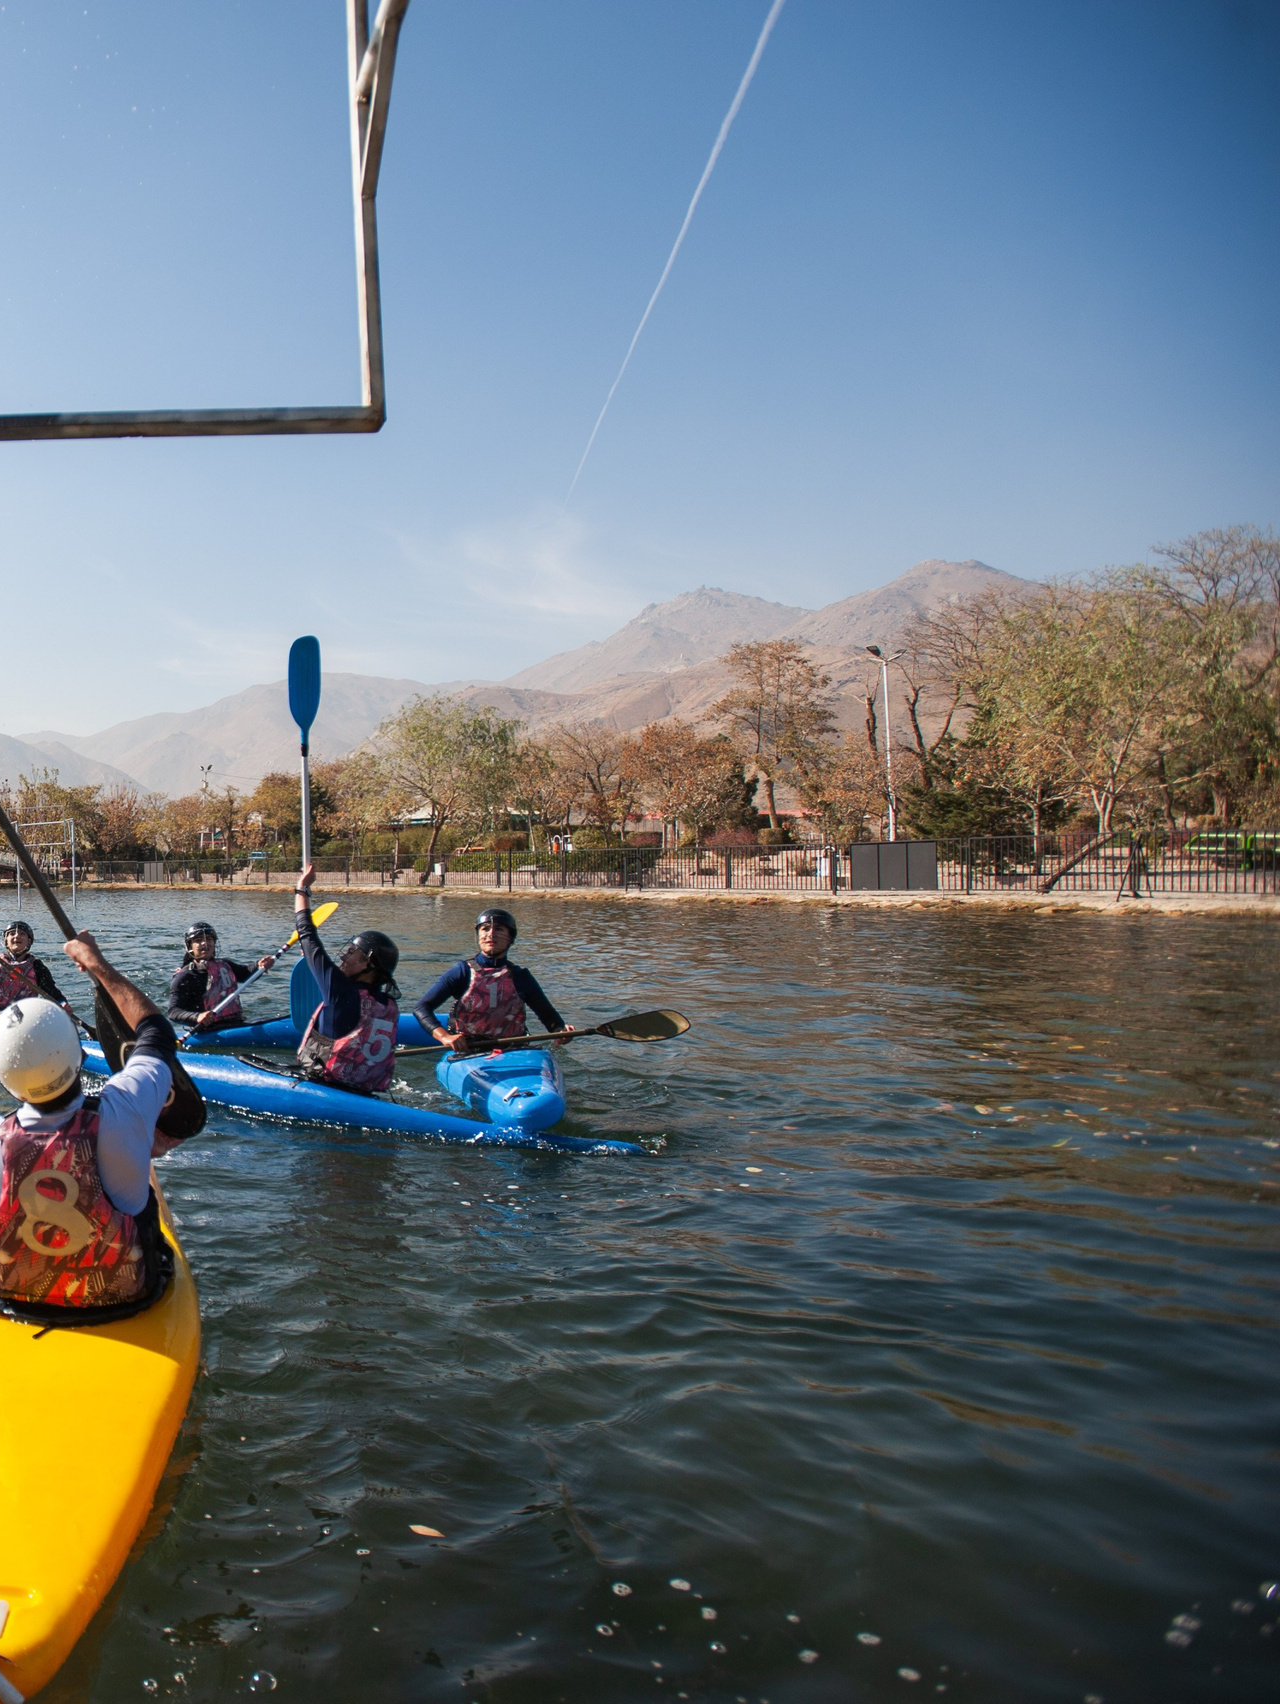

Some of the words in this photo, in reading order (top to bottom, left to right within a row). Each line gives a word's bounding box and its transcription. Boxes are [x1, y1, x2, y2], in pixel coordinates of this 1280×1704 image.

[485, 982, 498, 1008] 1
[362, 1018, 394, 1063] 5
[18, 1169, 91, 1257] 8
